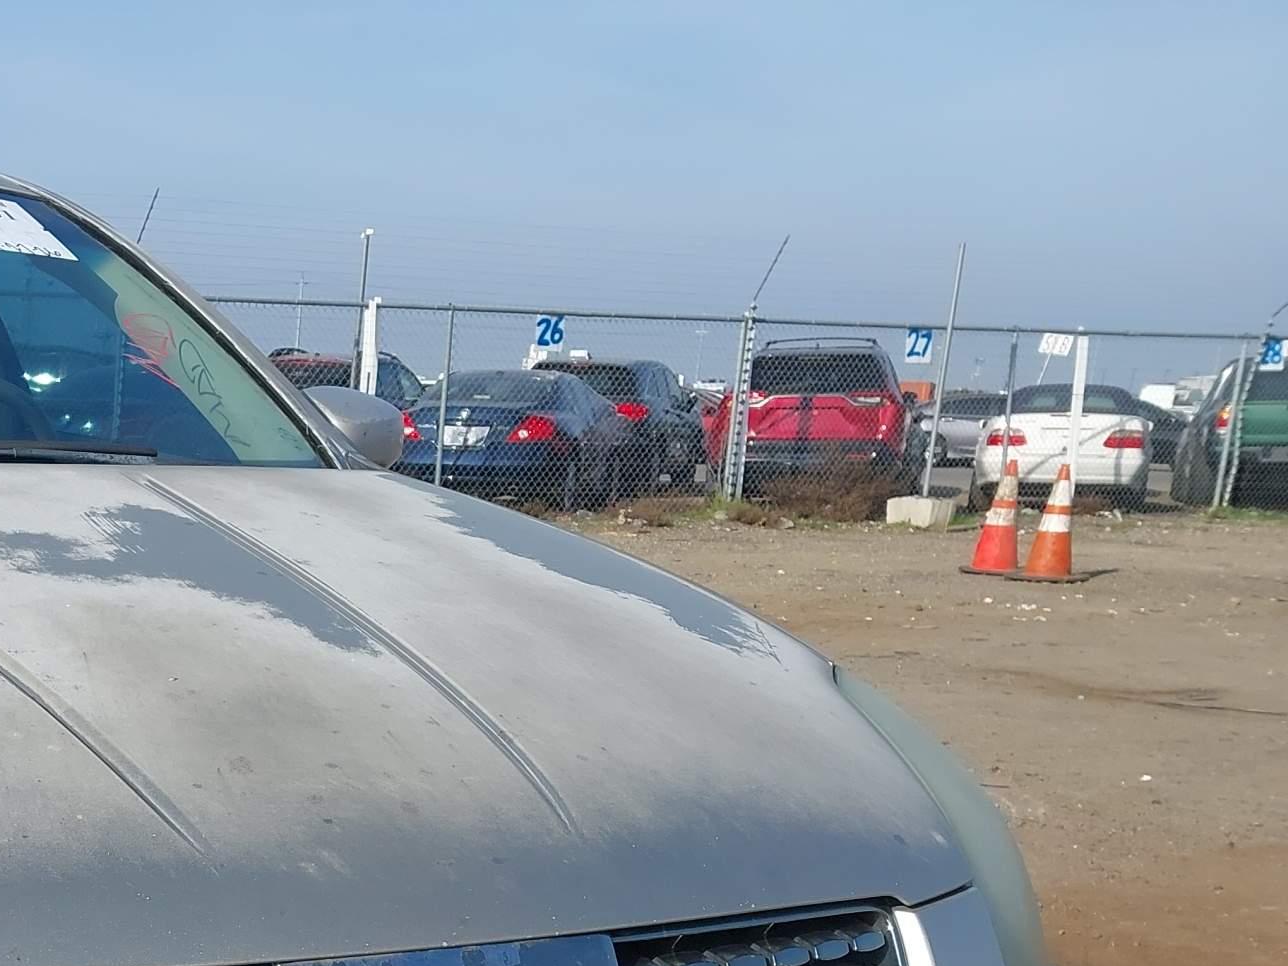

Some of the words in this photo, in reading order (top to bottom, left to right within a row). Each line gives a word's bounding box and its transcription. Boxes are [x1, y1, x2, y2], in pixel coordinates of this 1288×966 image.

[536, 315, 565, 347] 26
[907, 328, 932, 357] 27
[1261, 338, 1282, 364] 28
